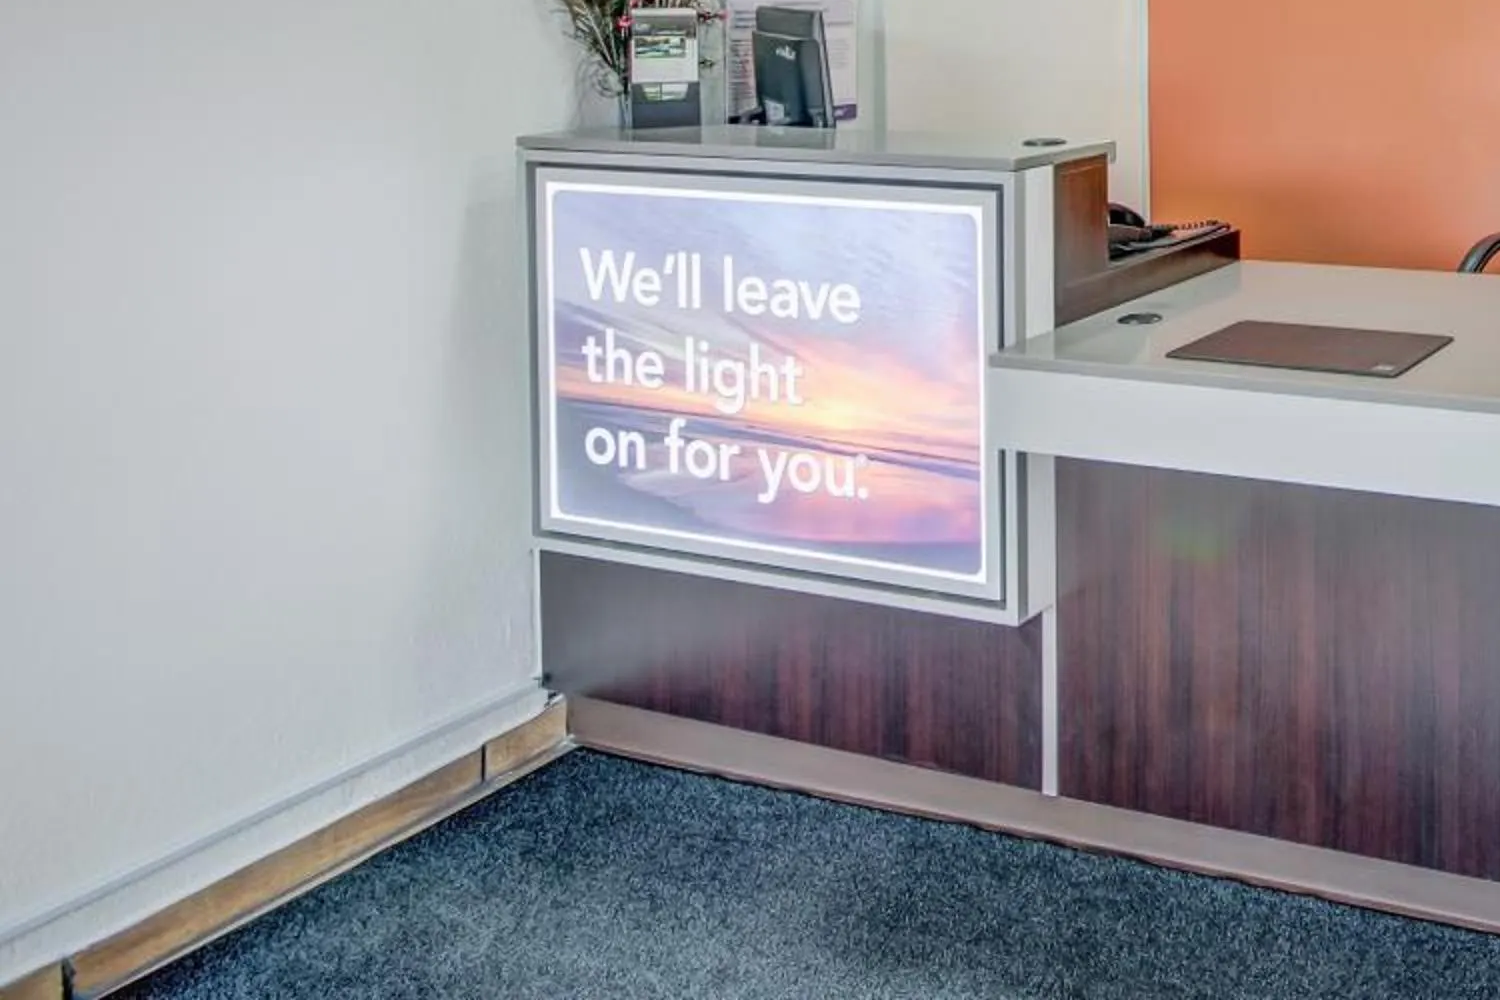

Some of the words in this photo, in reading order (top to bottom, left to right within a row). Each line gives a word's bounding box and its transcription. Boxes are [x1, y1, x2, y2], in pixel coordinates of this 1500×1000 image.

[579, 247, 701, 309] We'll
[724, 256, 862, 324] leave
[582, 328, 665, 388] the
[685, 336, 804, 414] light
[584, 426, 646, 471] on
[665, 419, 741, 481] for
